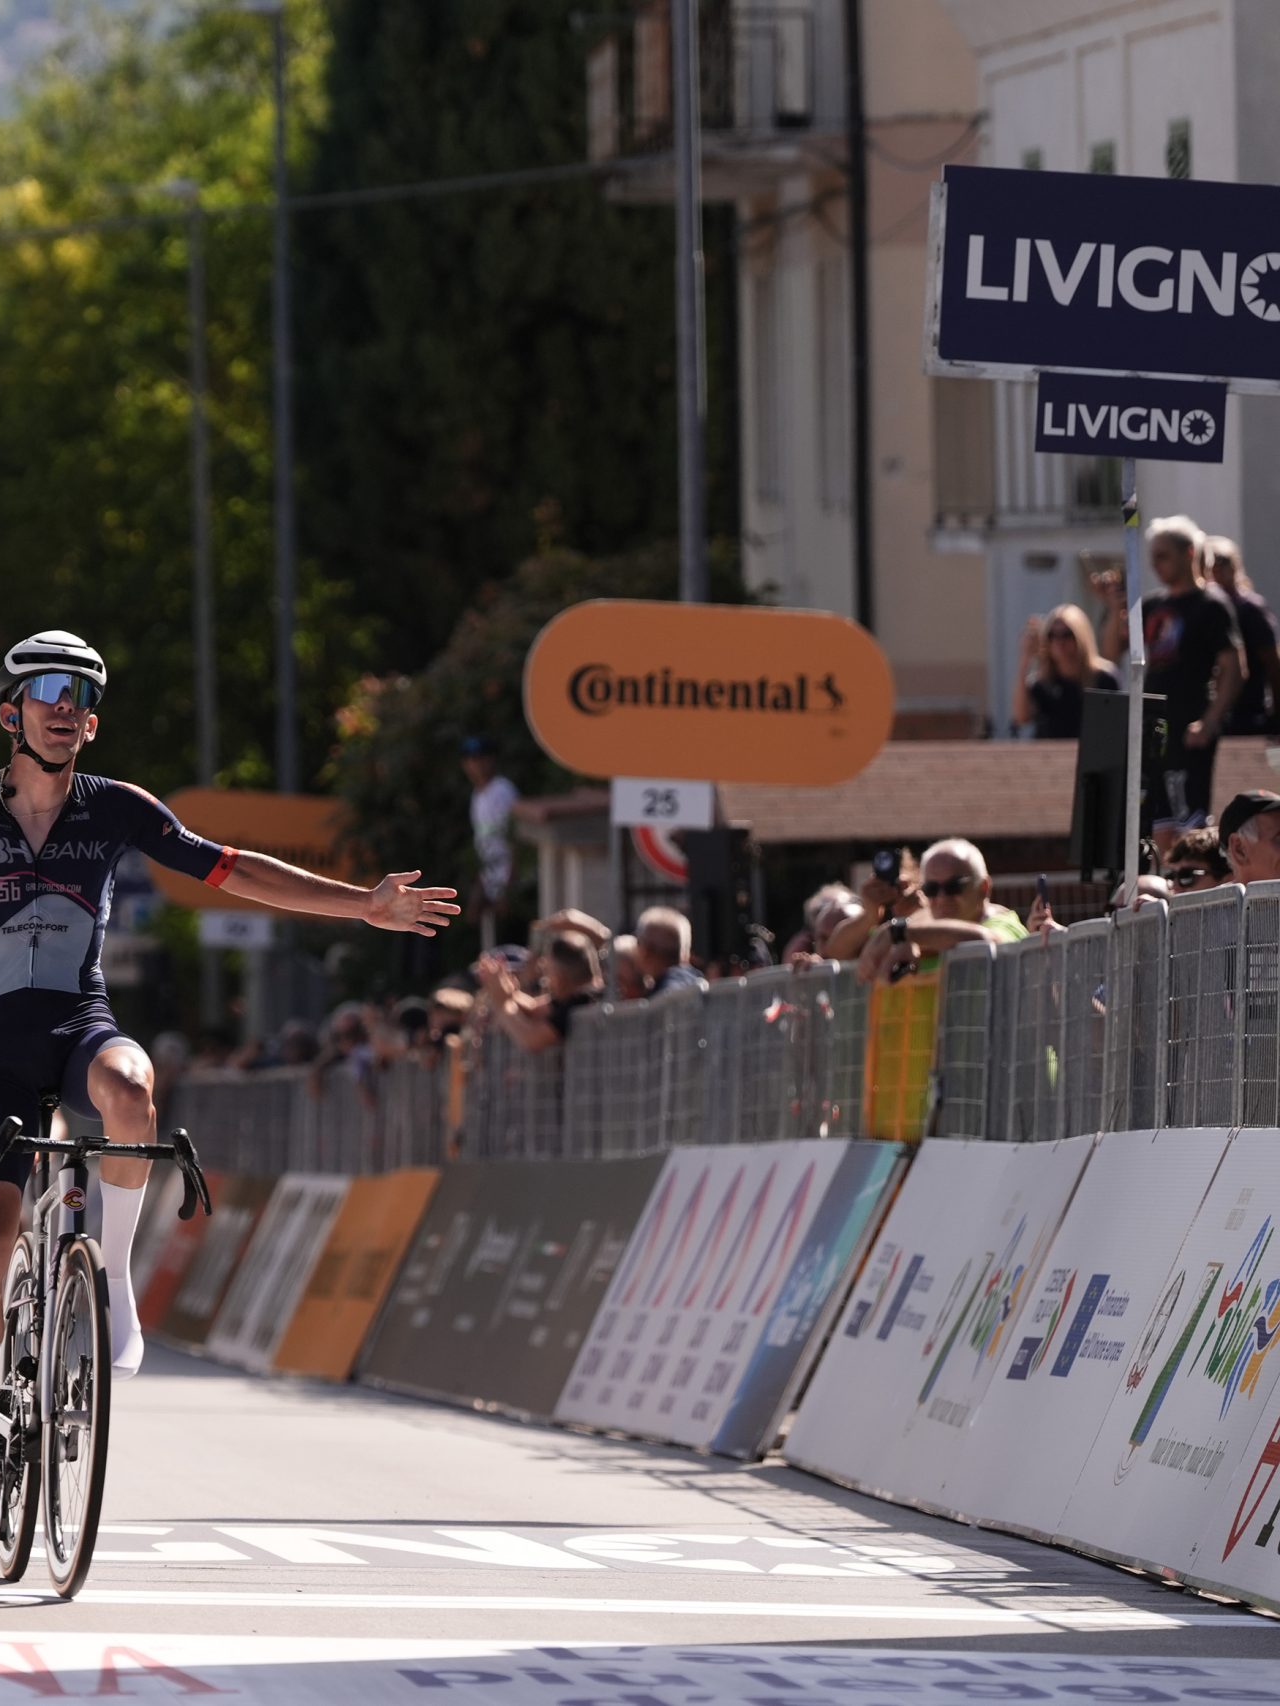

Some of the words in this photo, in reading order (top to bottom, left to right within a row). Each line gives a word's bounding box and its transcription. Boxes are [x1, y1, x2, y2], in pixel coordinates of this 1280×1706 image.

[966, 234, 1280, 322] LIVIGNO
[1042, 402, 1216, 446] LIVIGNO
[568, 663, 807, 716] Continental
[643, 787, 680, 817] 25
[40, 840, 110, 861] BANK
[1, 922, 70, 935] TELECOM-FORT
[395, 1666, 701, 1689] più
